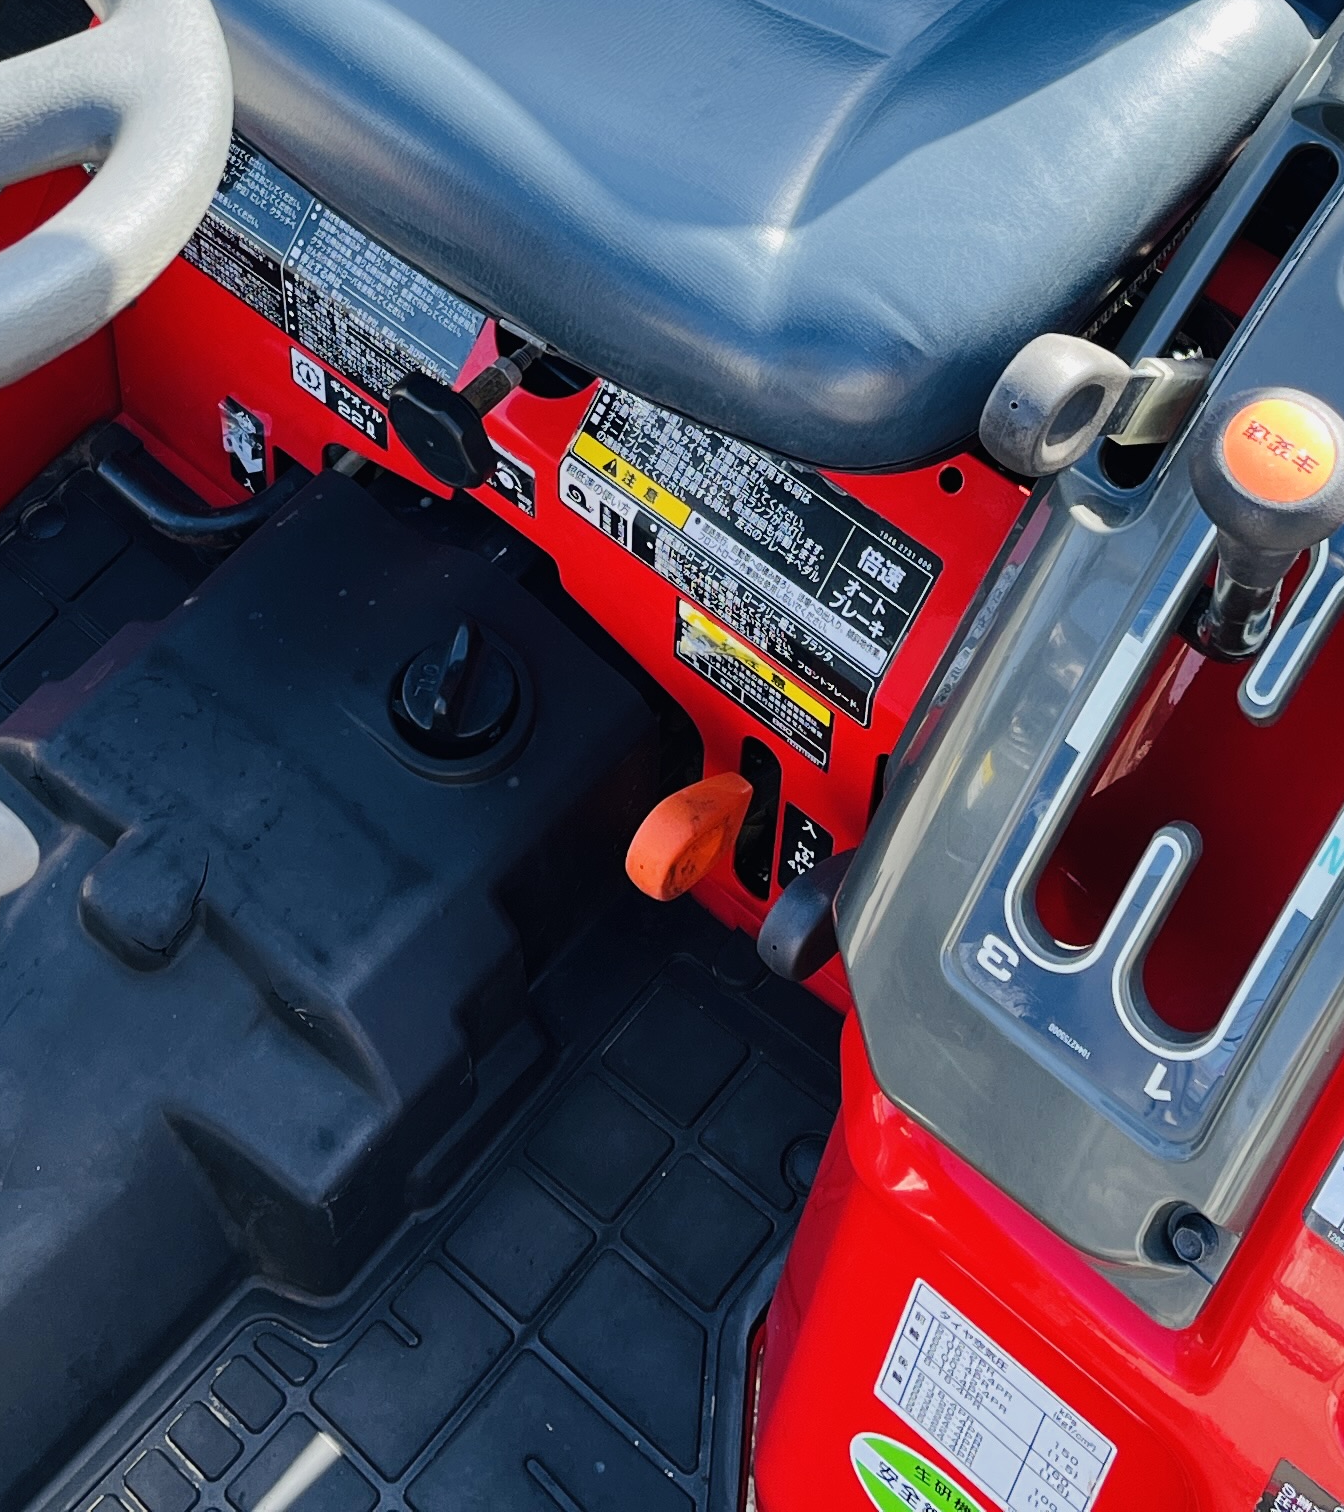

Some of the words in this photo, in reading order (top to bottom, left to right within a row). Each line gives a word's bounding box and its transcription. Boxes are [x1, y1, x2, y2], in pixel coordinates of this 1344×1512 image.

[1241, 419, 1319, 473] 主変速
[621, 470, 660, 504] 注意
[855, 544, 907, 593] 倍速
[826, 589, 887, 641] ブレーキ
[841, 577, 889, 618] オート
[977, 934, 1019, 982] 3
[1143, 1063, 1173, 1102] 1
[939, 1308, 1008, 1373] タイヤ空気圧
[1053, 1441, 1079, 1467] 150
[1033, 1488, 1057, 1512] 100
